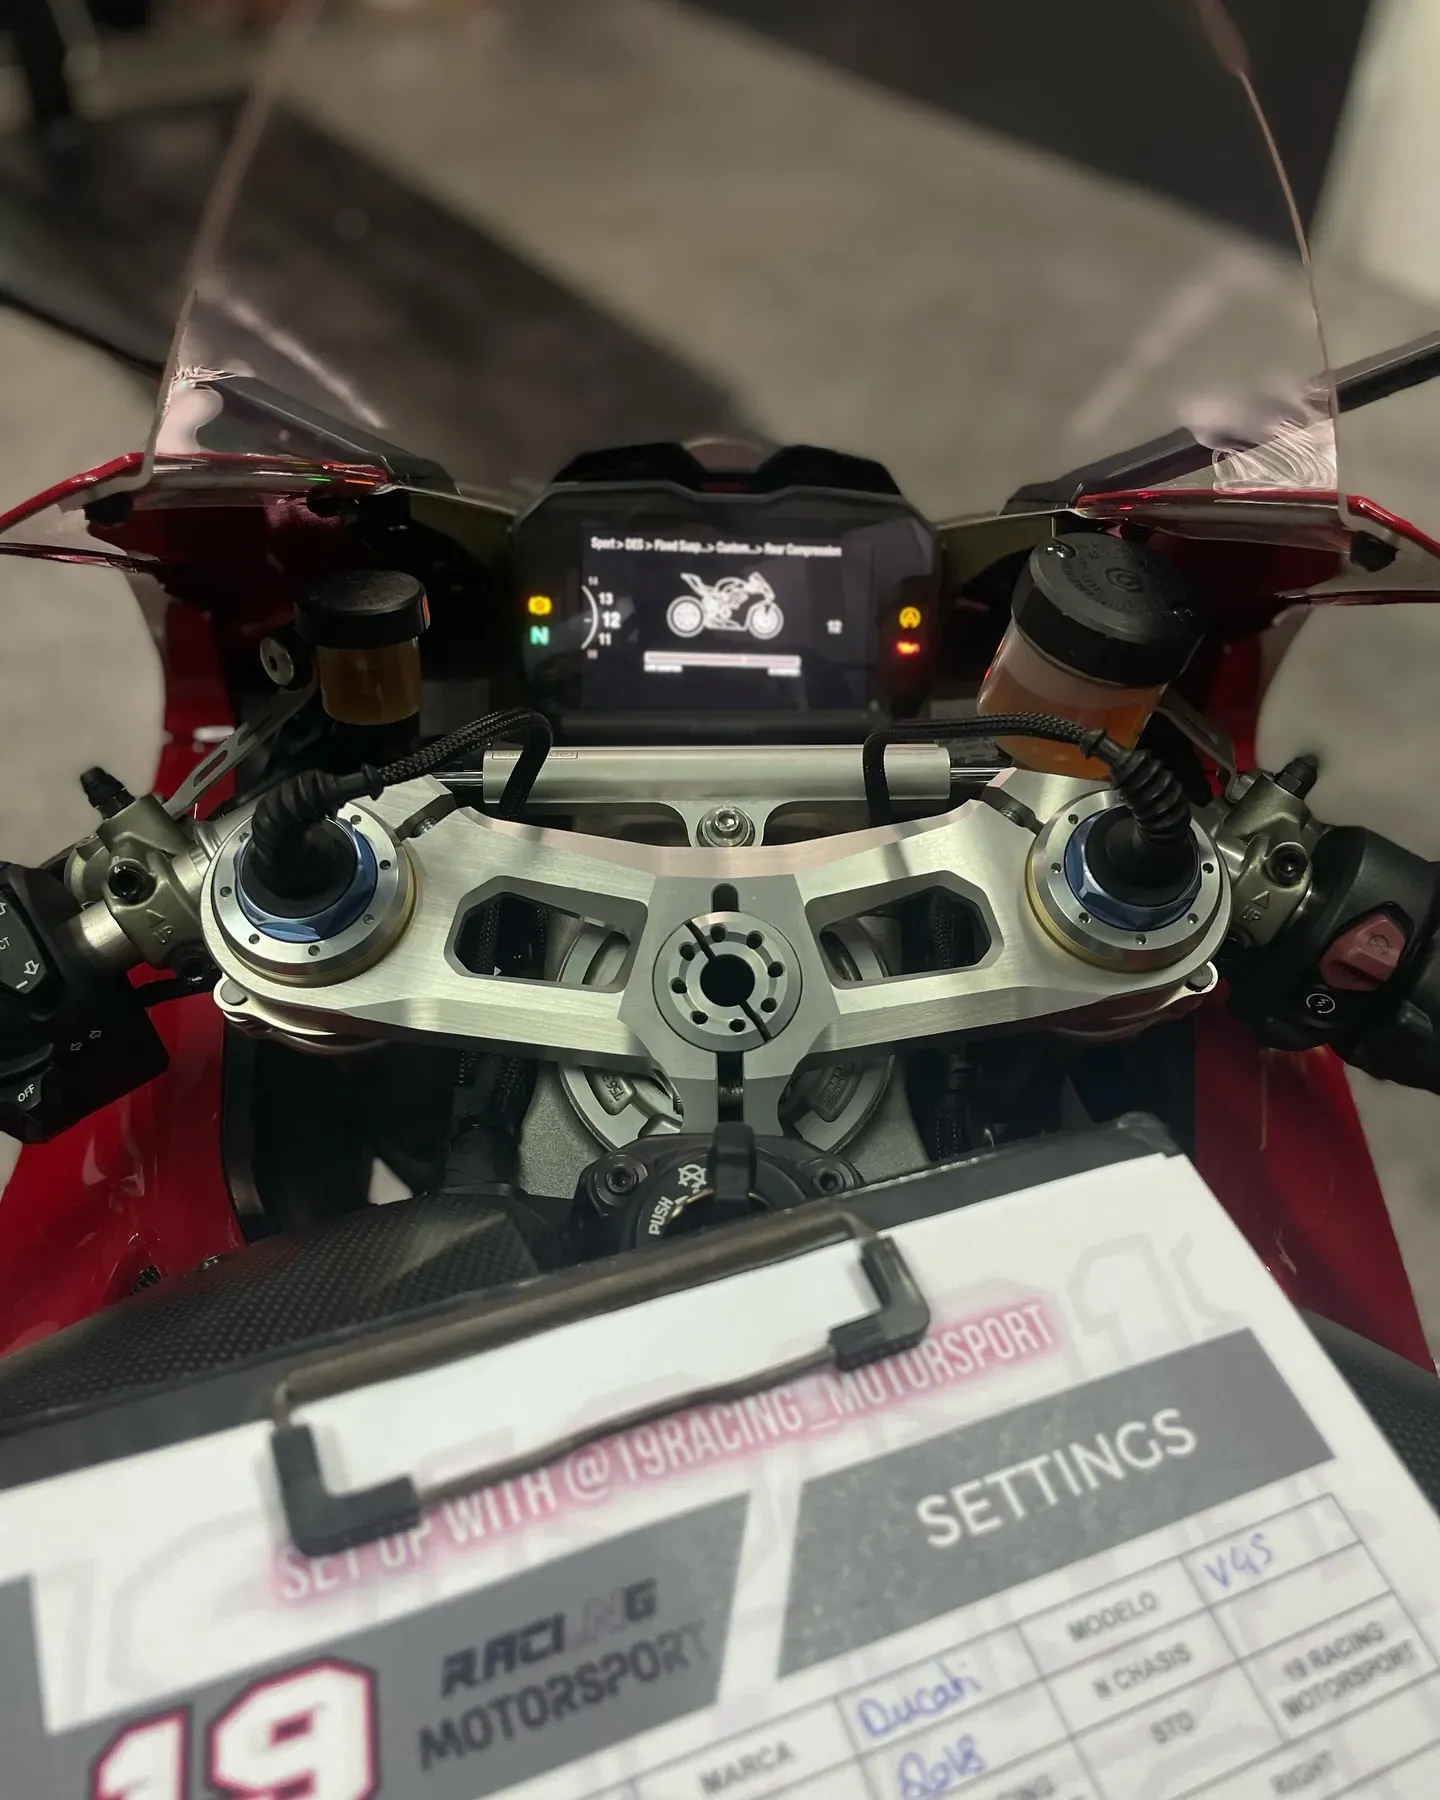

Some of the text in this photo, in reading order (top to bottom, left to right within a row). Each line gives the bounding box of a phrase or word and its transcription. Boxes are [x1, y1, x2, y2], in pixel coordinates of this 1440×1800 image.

[786, 543, 842, 558] Compression
[599, 592, 614, 606] 13
[603, 611, 622, 629] 12
[530, 626, 550, 646] N
[599, 632, 611, 646] 11
[17, 1083, 36, 1103] OFF
[648, 1195, 675, 1236] PUSH
[915, 1407, 1198, 1548] SETTINGS
[441, 1467, 556, 1543] WITH
[441, 1577, 657, 1698] RACING
[1067, 1590, 1159, 1641] MODELO
[1112, 1642, 1192, 1691] CHASIS
[1307, 1622, 1385, 1670] RACING
[418, 1618, 709, 1772] MOTORSPORT
[1279, 1639, 1413, 1720] MOTORSPORT
[700, 1740, 797, 1795] MARCA
